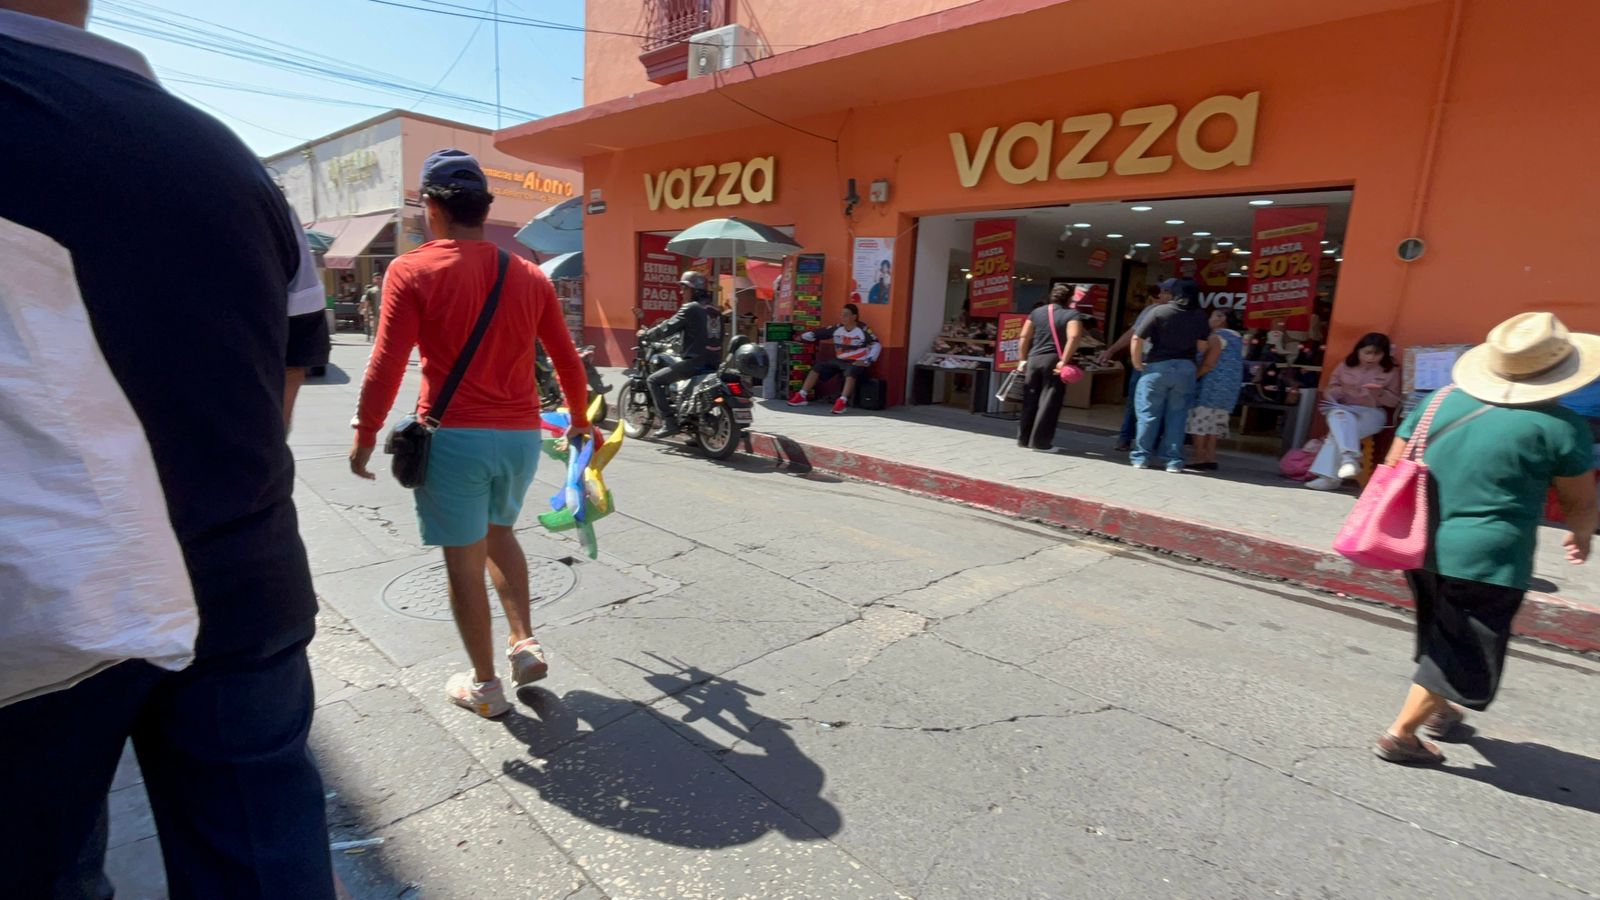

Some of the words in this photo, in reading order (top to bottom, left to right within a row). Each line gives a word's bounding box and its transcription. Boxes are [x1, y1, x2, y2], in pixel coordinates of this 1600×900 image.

[948, 91, 1260, 188] vazza
[643, 156, 775, 211] vazza
[1260, 242, 1303, 256] HASTA
[974, 255, 1010, 278] 50%
[1253, 252, 1313, 279] 50%
[643, 288, 677, 302] PAGA
[1251, 283, 1270, 294] EN
[1272, 278, 1311, 292] TODA
[1198, 291, 1248, 310] vaz
[1250, 294, 1265, 304] LA
[1267, 289, 1309, 302] TIENDA
